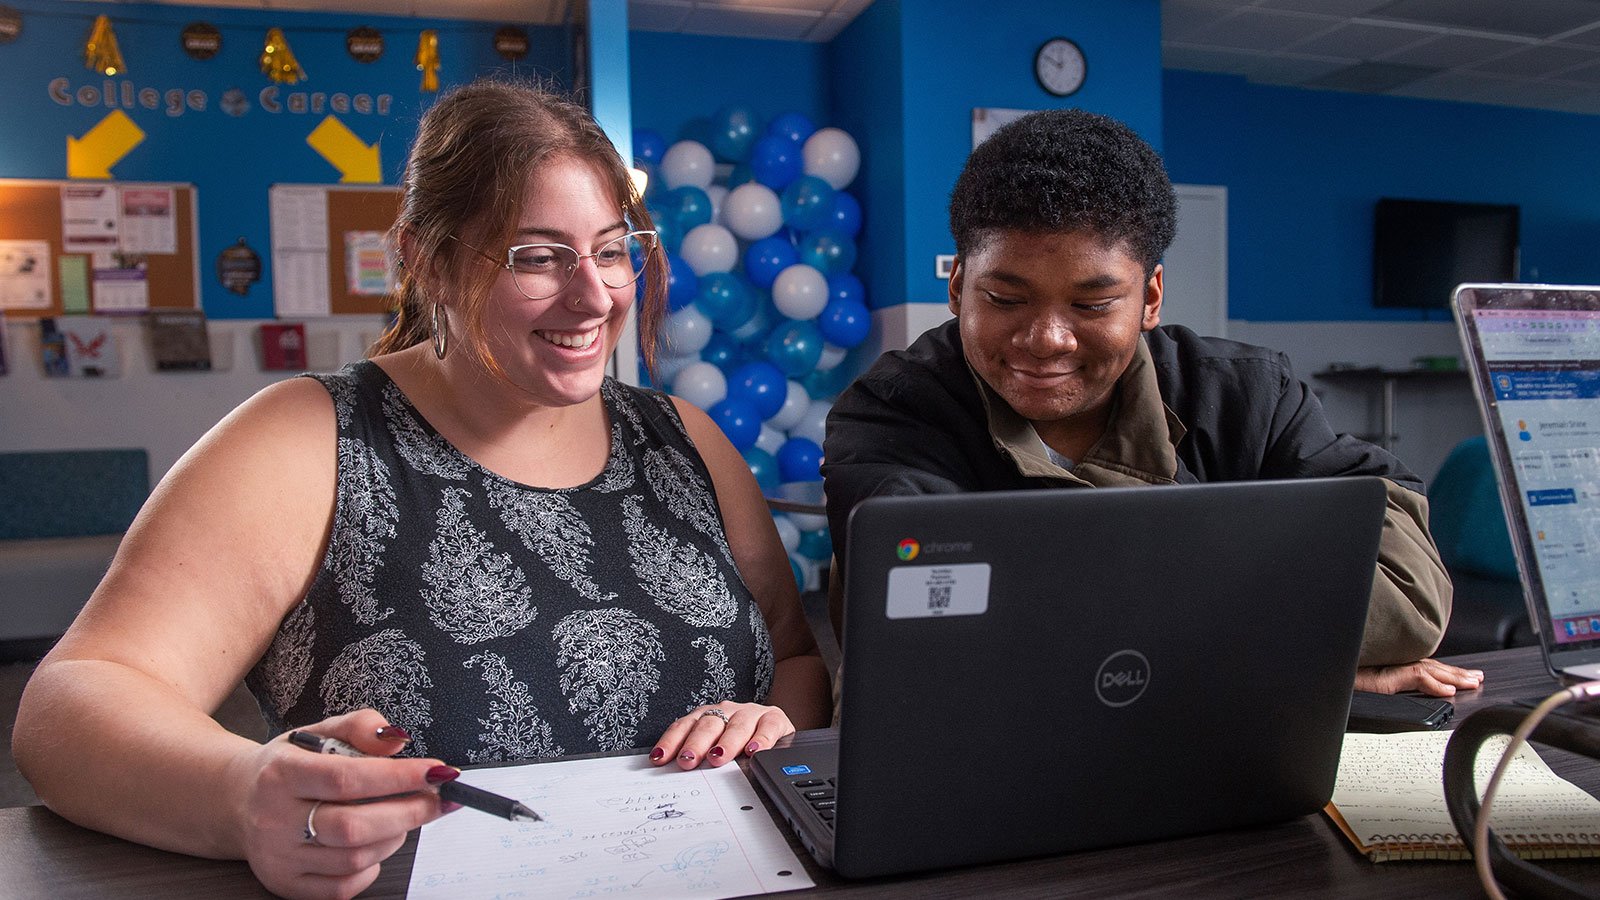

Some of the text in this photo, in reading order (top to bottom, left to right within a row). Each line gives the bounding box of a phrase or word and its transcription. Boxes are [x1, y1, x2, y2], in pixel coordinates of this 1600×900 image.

[48, 78, 393, 117] College Career
[925, 541, 973, 553] chrome
[1102, 670, 1145, 688] DELL
